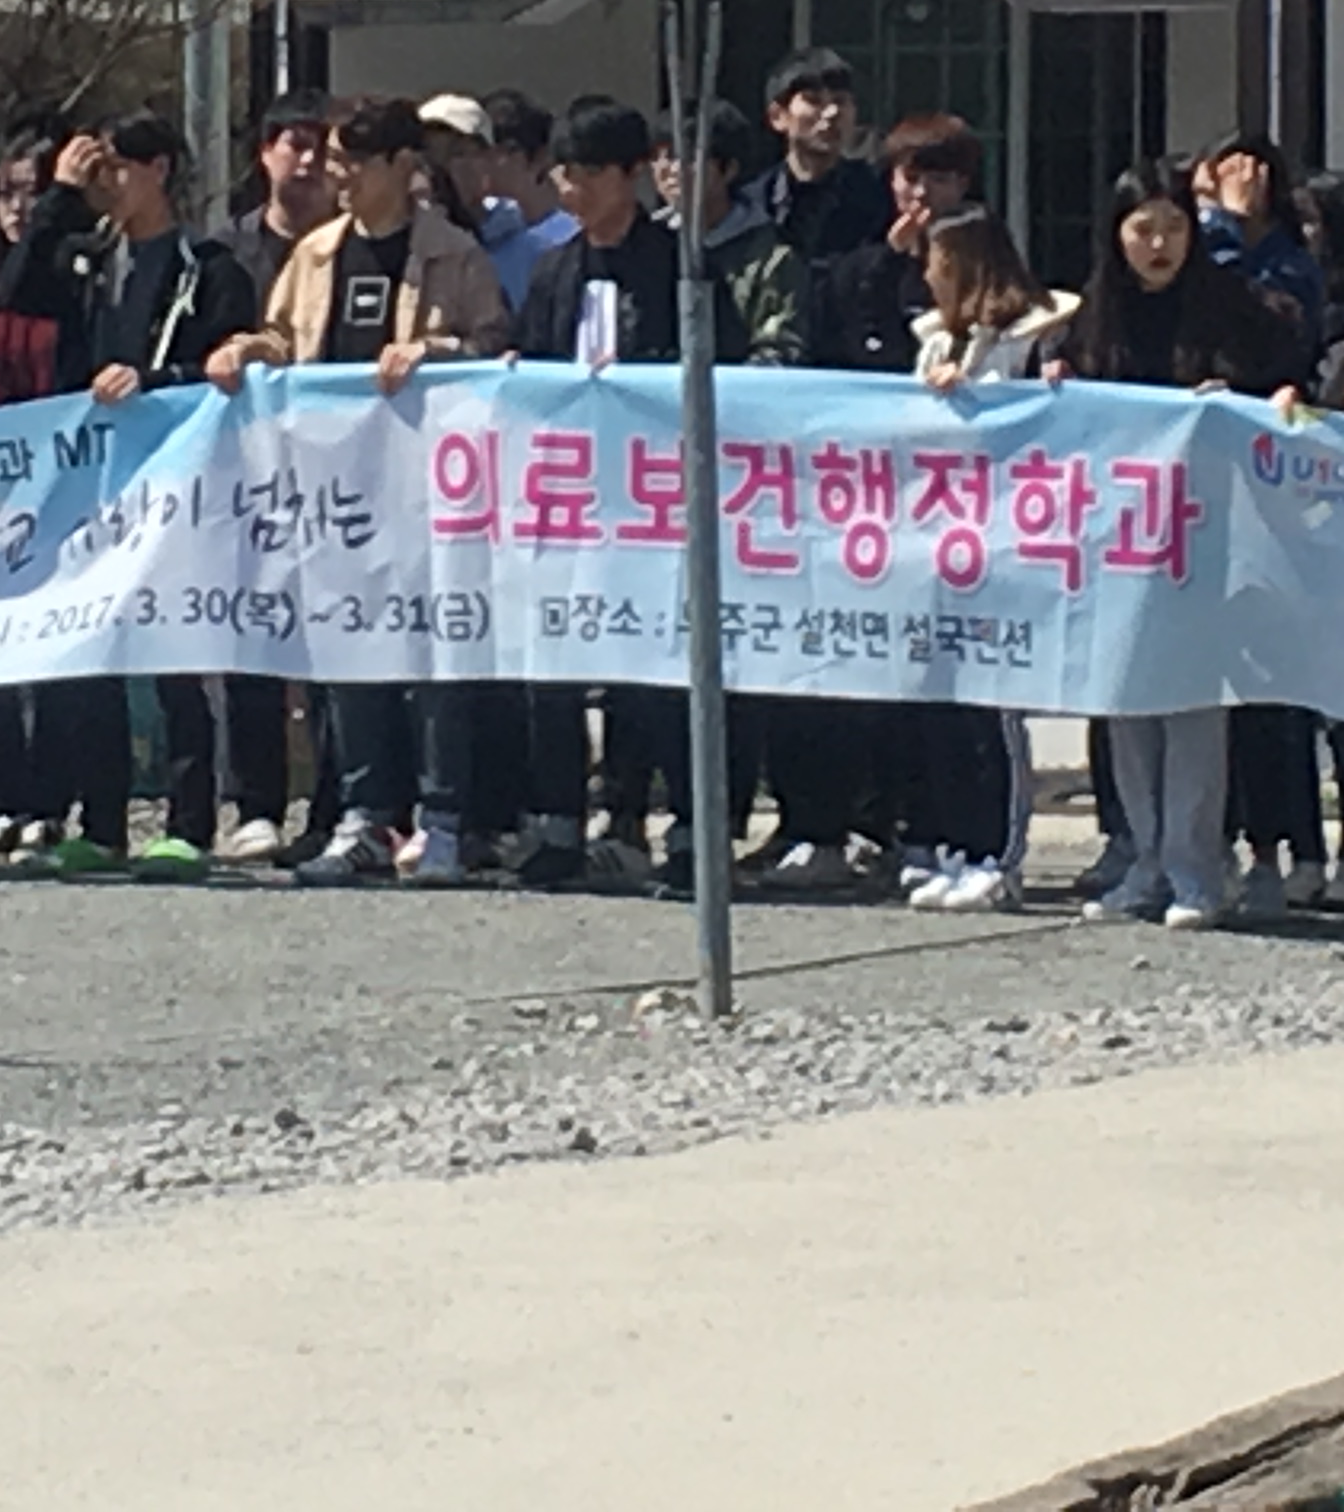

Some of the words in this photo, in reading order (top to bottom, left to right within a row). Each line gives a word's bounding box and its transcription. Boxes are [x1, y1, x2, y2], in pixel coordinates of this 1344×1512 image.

[53, 423, 115, 468] MT
[232, 465, 377, 554] 넘치는
[430, 429, 1205, 593] 의료보건행정학과
[385, 589, 491, 642] 31(금)
[794, 606, 891, 660] 설천면
